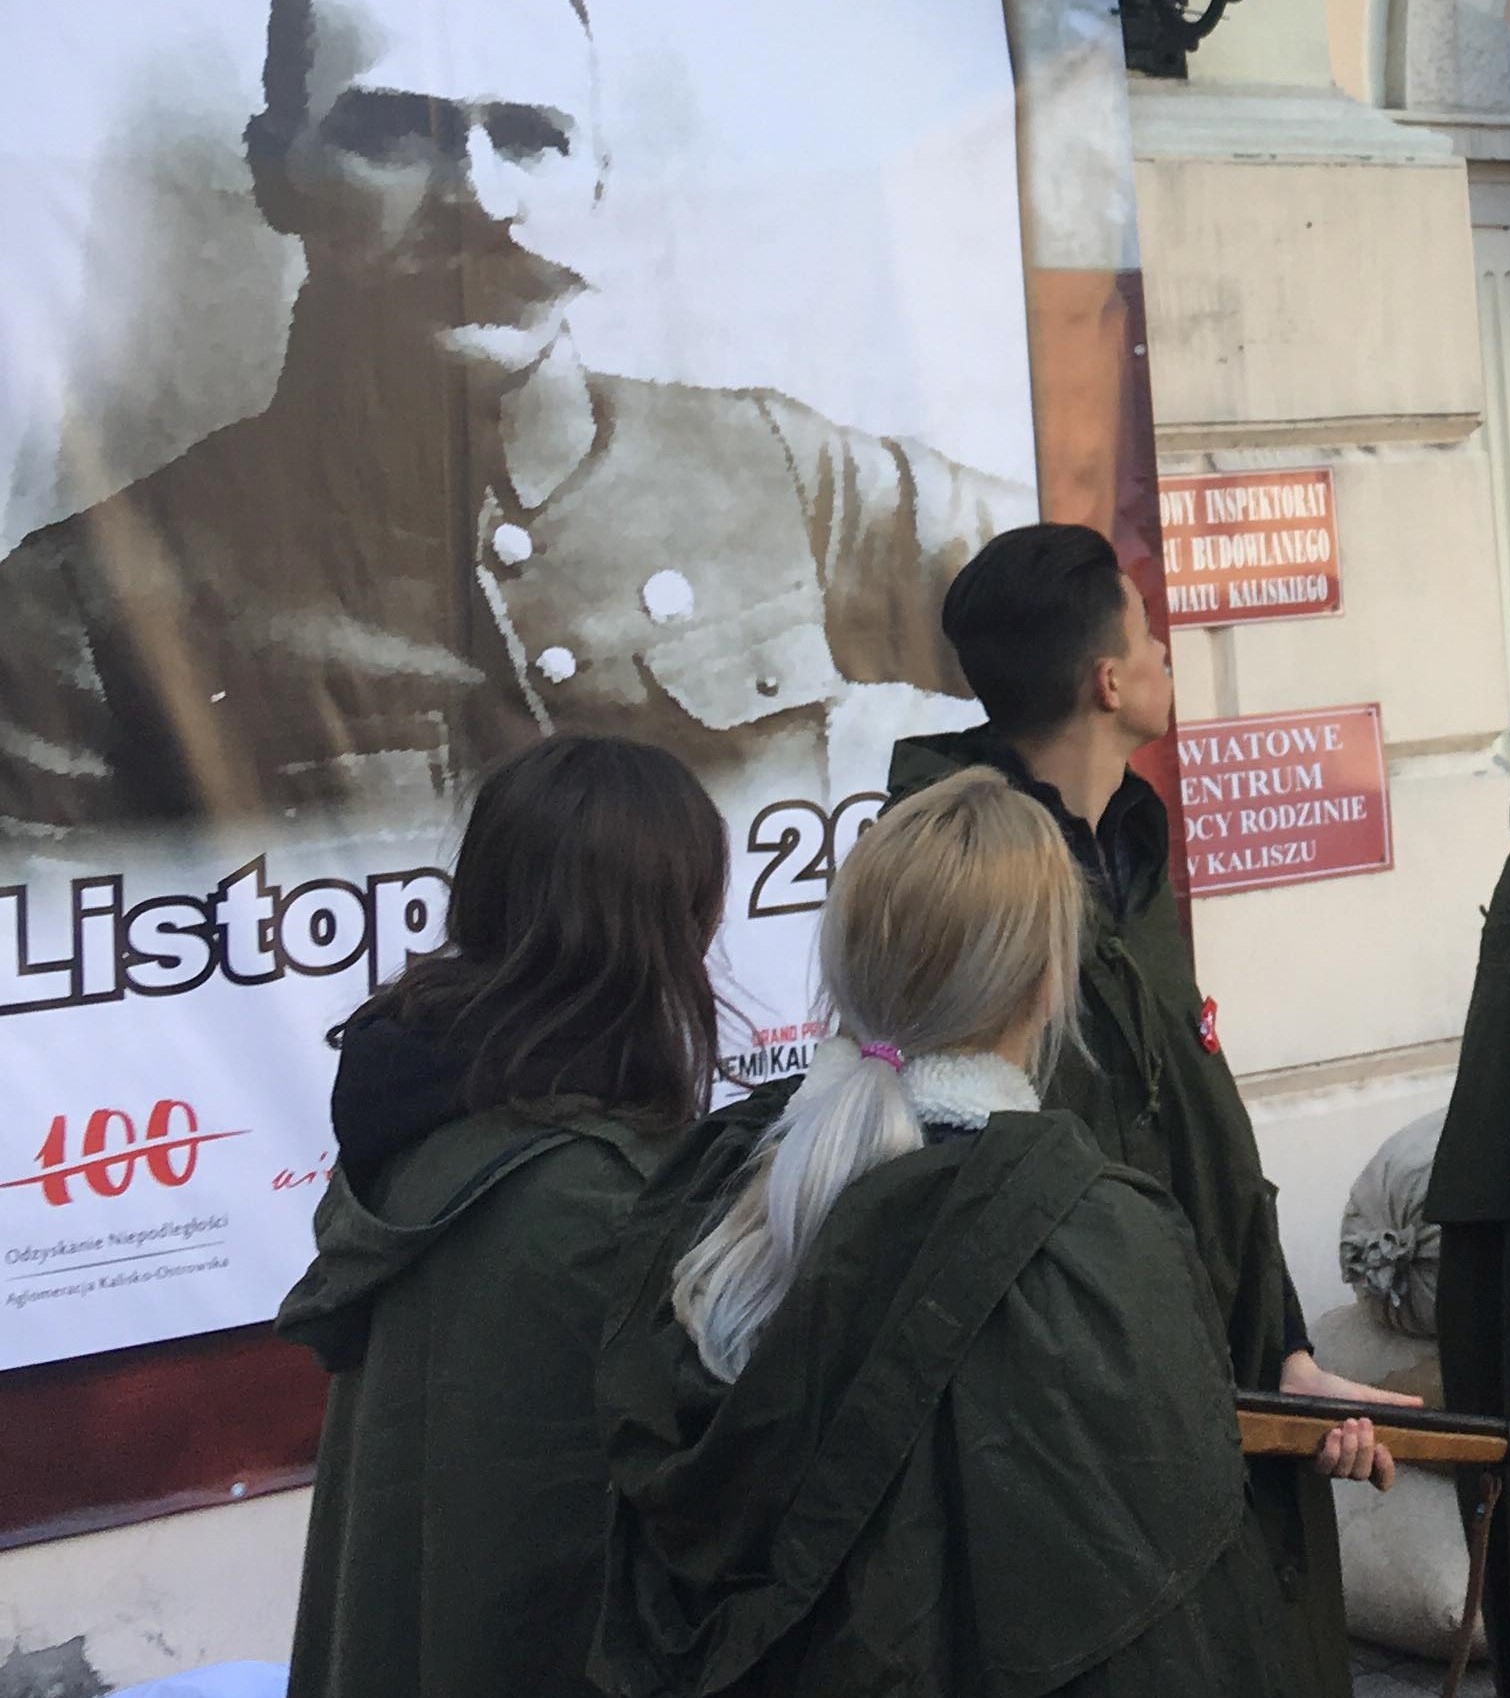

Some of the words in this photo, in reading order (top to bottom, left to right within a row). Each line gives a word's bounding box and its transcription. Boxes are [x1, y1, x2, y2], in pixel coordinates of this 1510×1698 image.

[1206, 483, 1327, 524] INSPEKTORAT
[1191, 529, 1330, 571] BUDOWLANEGO
[1229, 573, 1328, 609] KALISKIEGO
[1178, 724, 1344, 767] WIATOWE
[1181, 762, 1323, 806] ENTRUM
[1240, 795, 1367, 835] RODZINIE
[1207, 839, 1317, 875] KALISZU
[770, 1042, 819, 1075] KAL
[34, 1099, 199, 1206] 100
[4, 1237, 104, 1265] Odzyskanie
